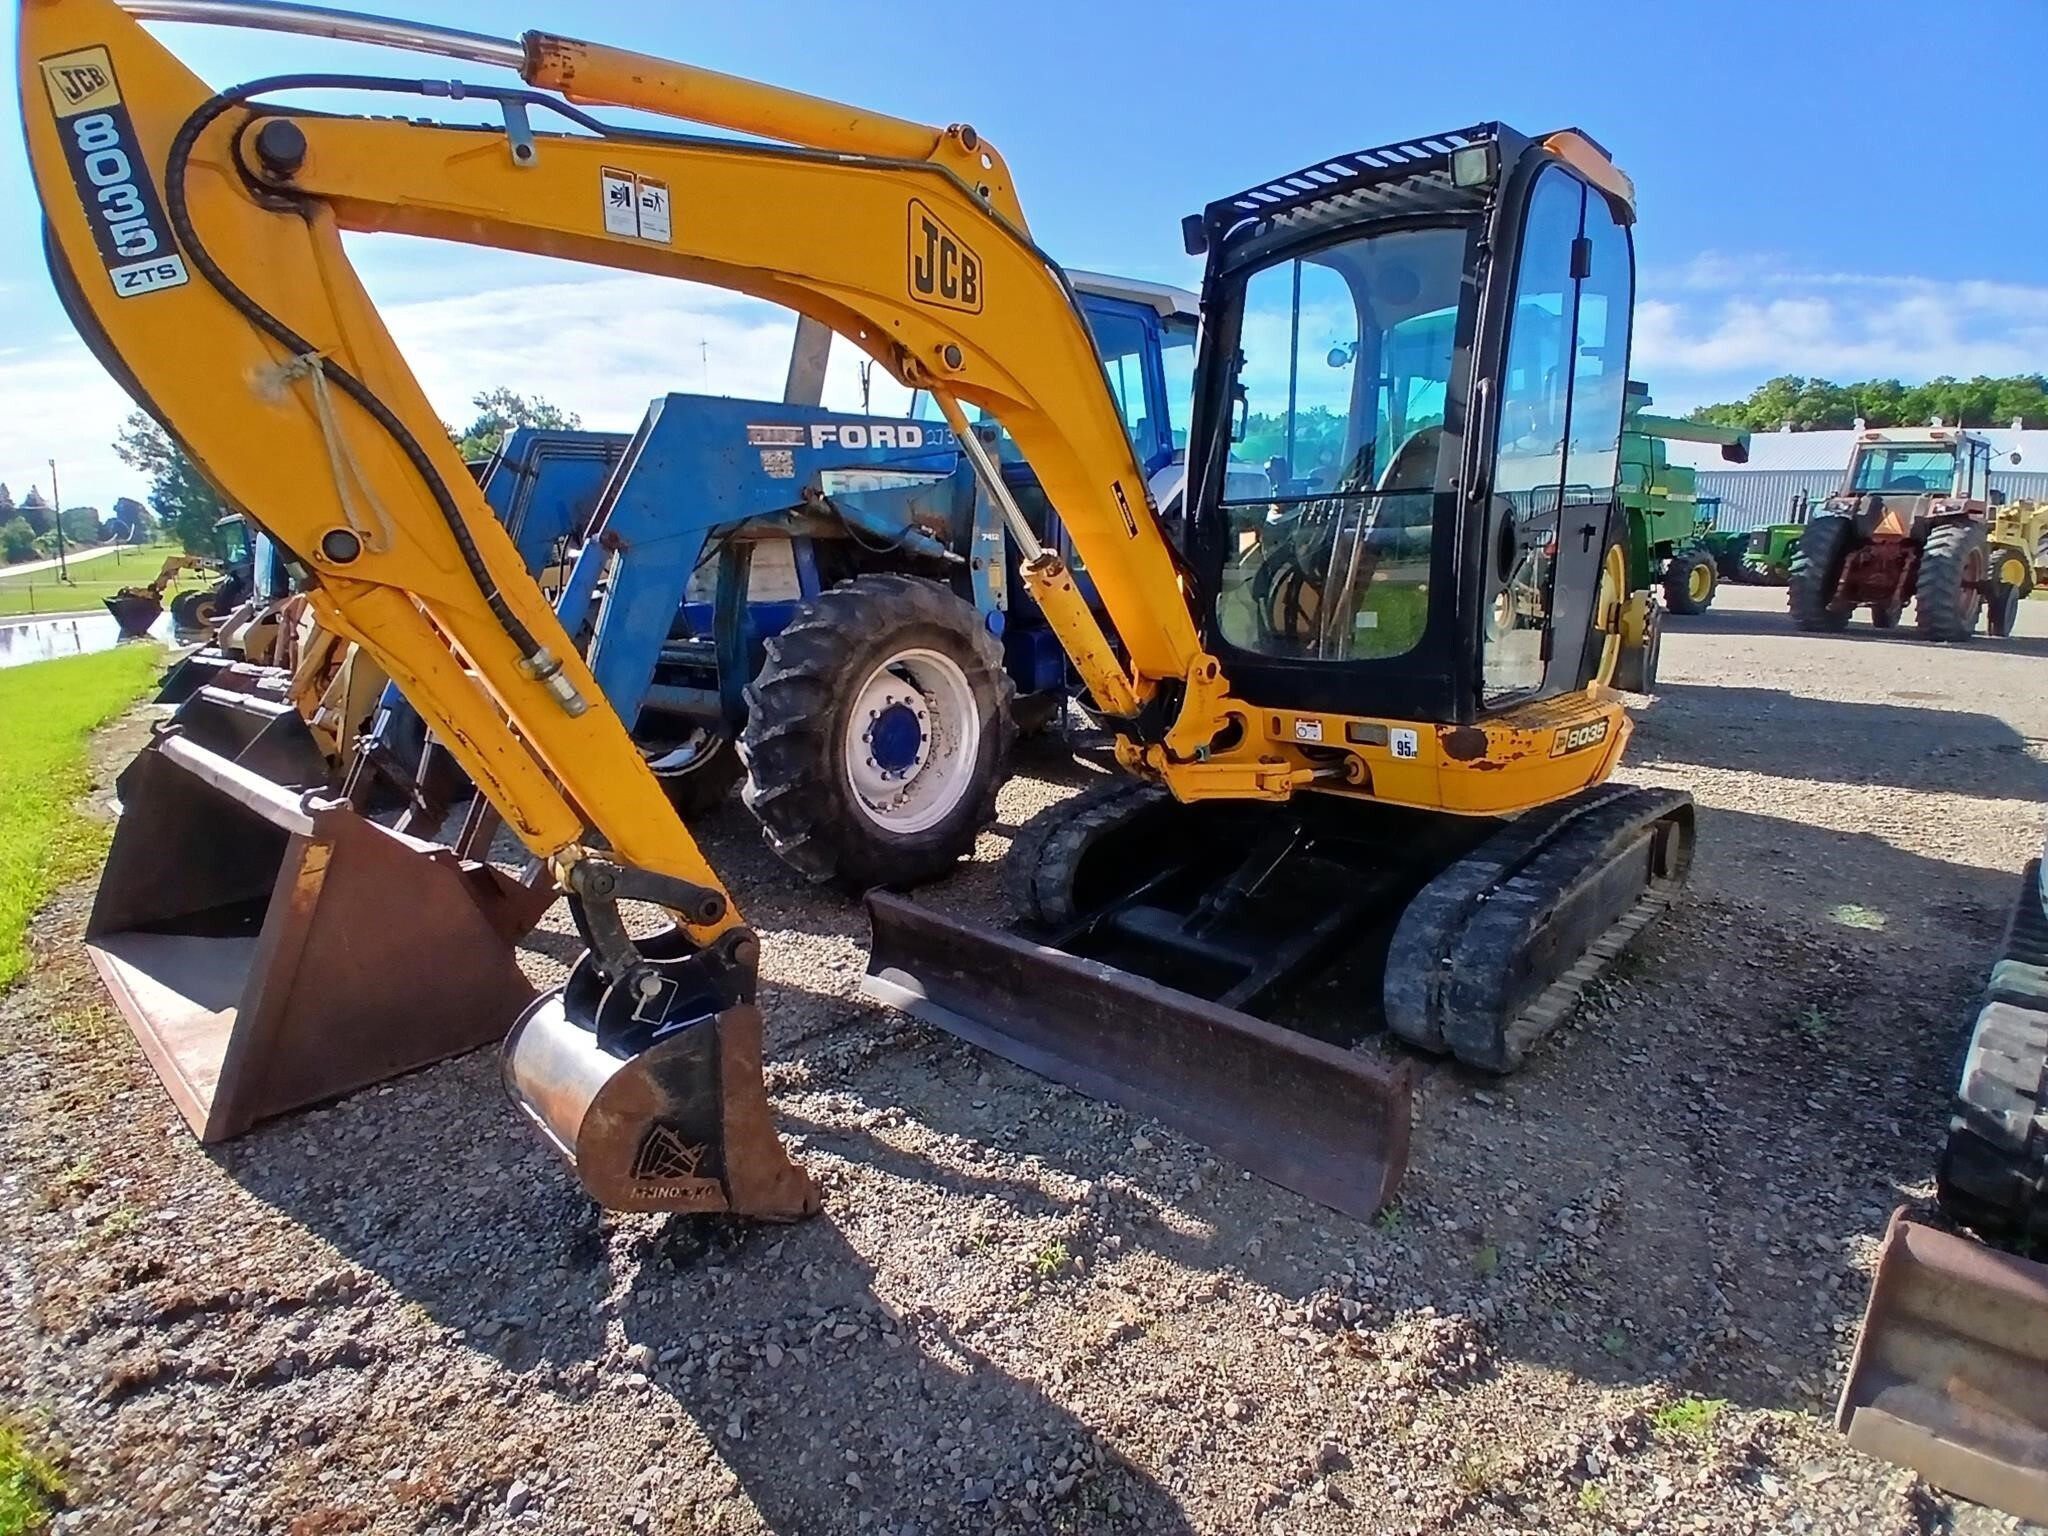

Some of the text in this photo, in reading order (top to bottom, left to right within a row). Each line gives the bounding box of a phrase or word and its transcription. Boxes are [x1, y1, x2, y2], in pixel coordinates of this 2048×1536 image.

[60, 68, 104, 101] JCB
[73, 113, 158, 257] 8035
[914, 215, 977, 305] JCB
[121, 263, 177, 288] ZTS
[810, 424, 923, 449] FORD
[1397, 740, 1411, 757] 95
[1567, 721, 1608, 749] 8035
